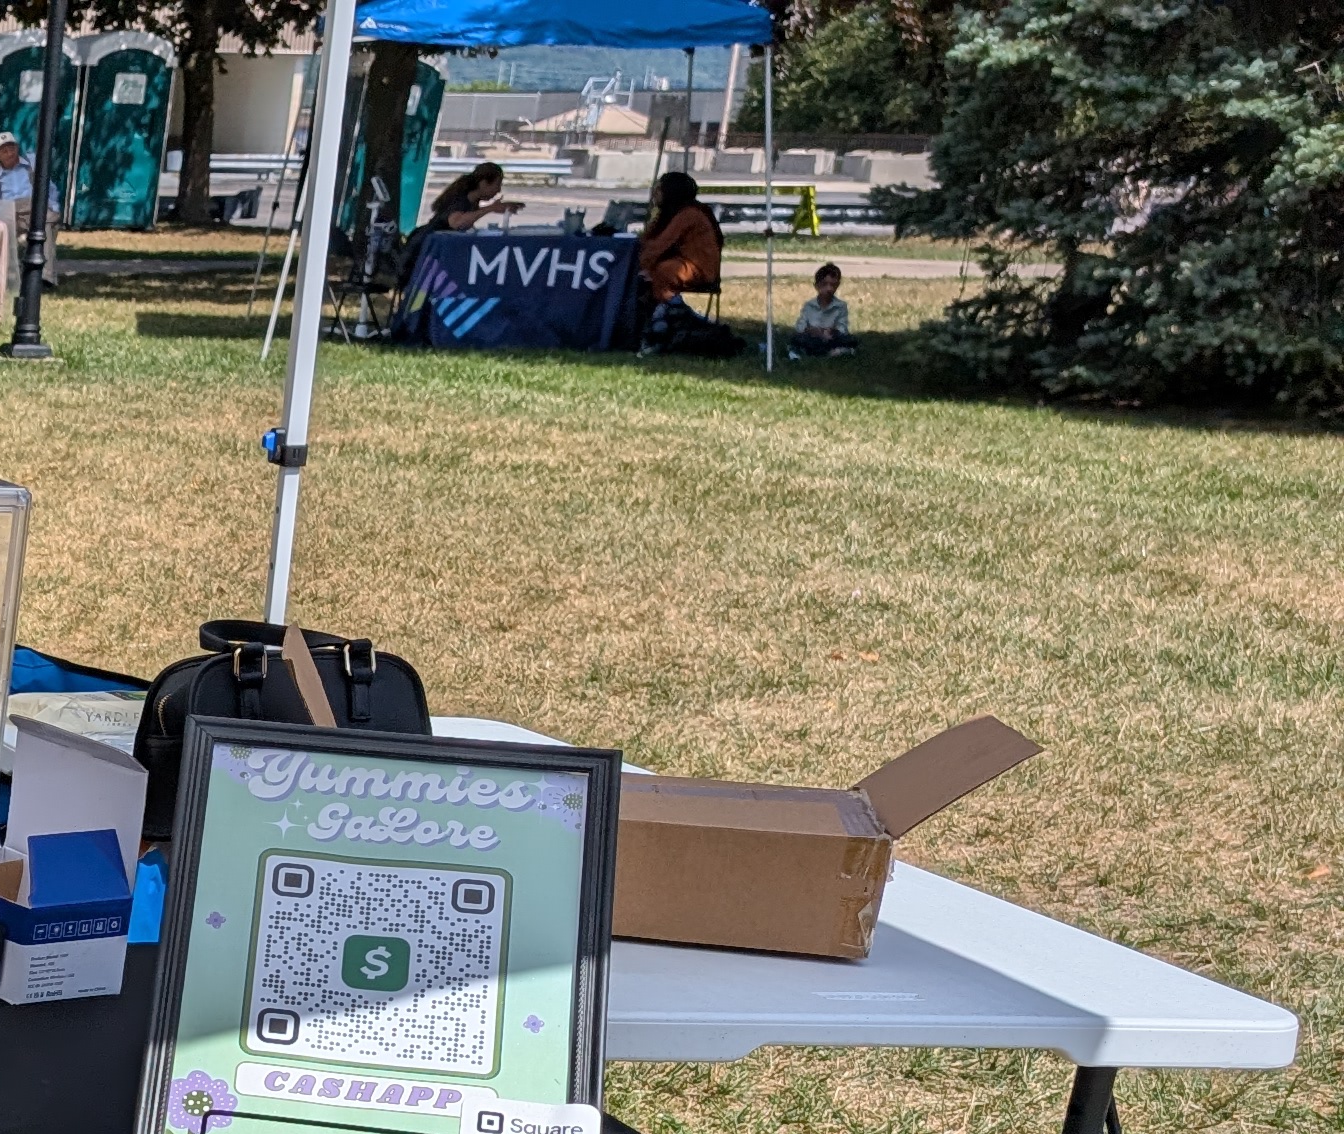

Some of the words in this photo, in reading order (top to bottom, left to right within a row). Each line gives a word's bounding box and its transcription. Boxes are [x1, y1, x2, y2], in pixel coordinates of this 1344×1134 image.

[468, 244, 615, 291] MVHS
[85, 711, 140, 722] YARDLE
[247, 747, 536, 813] Yummies
[264, 1071, 463, 1110] CASHAPP
